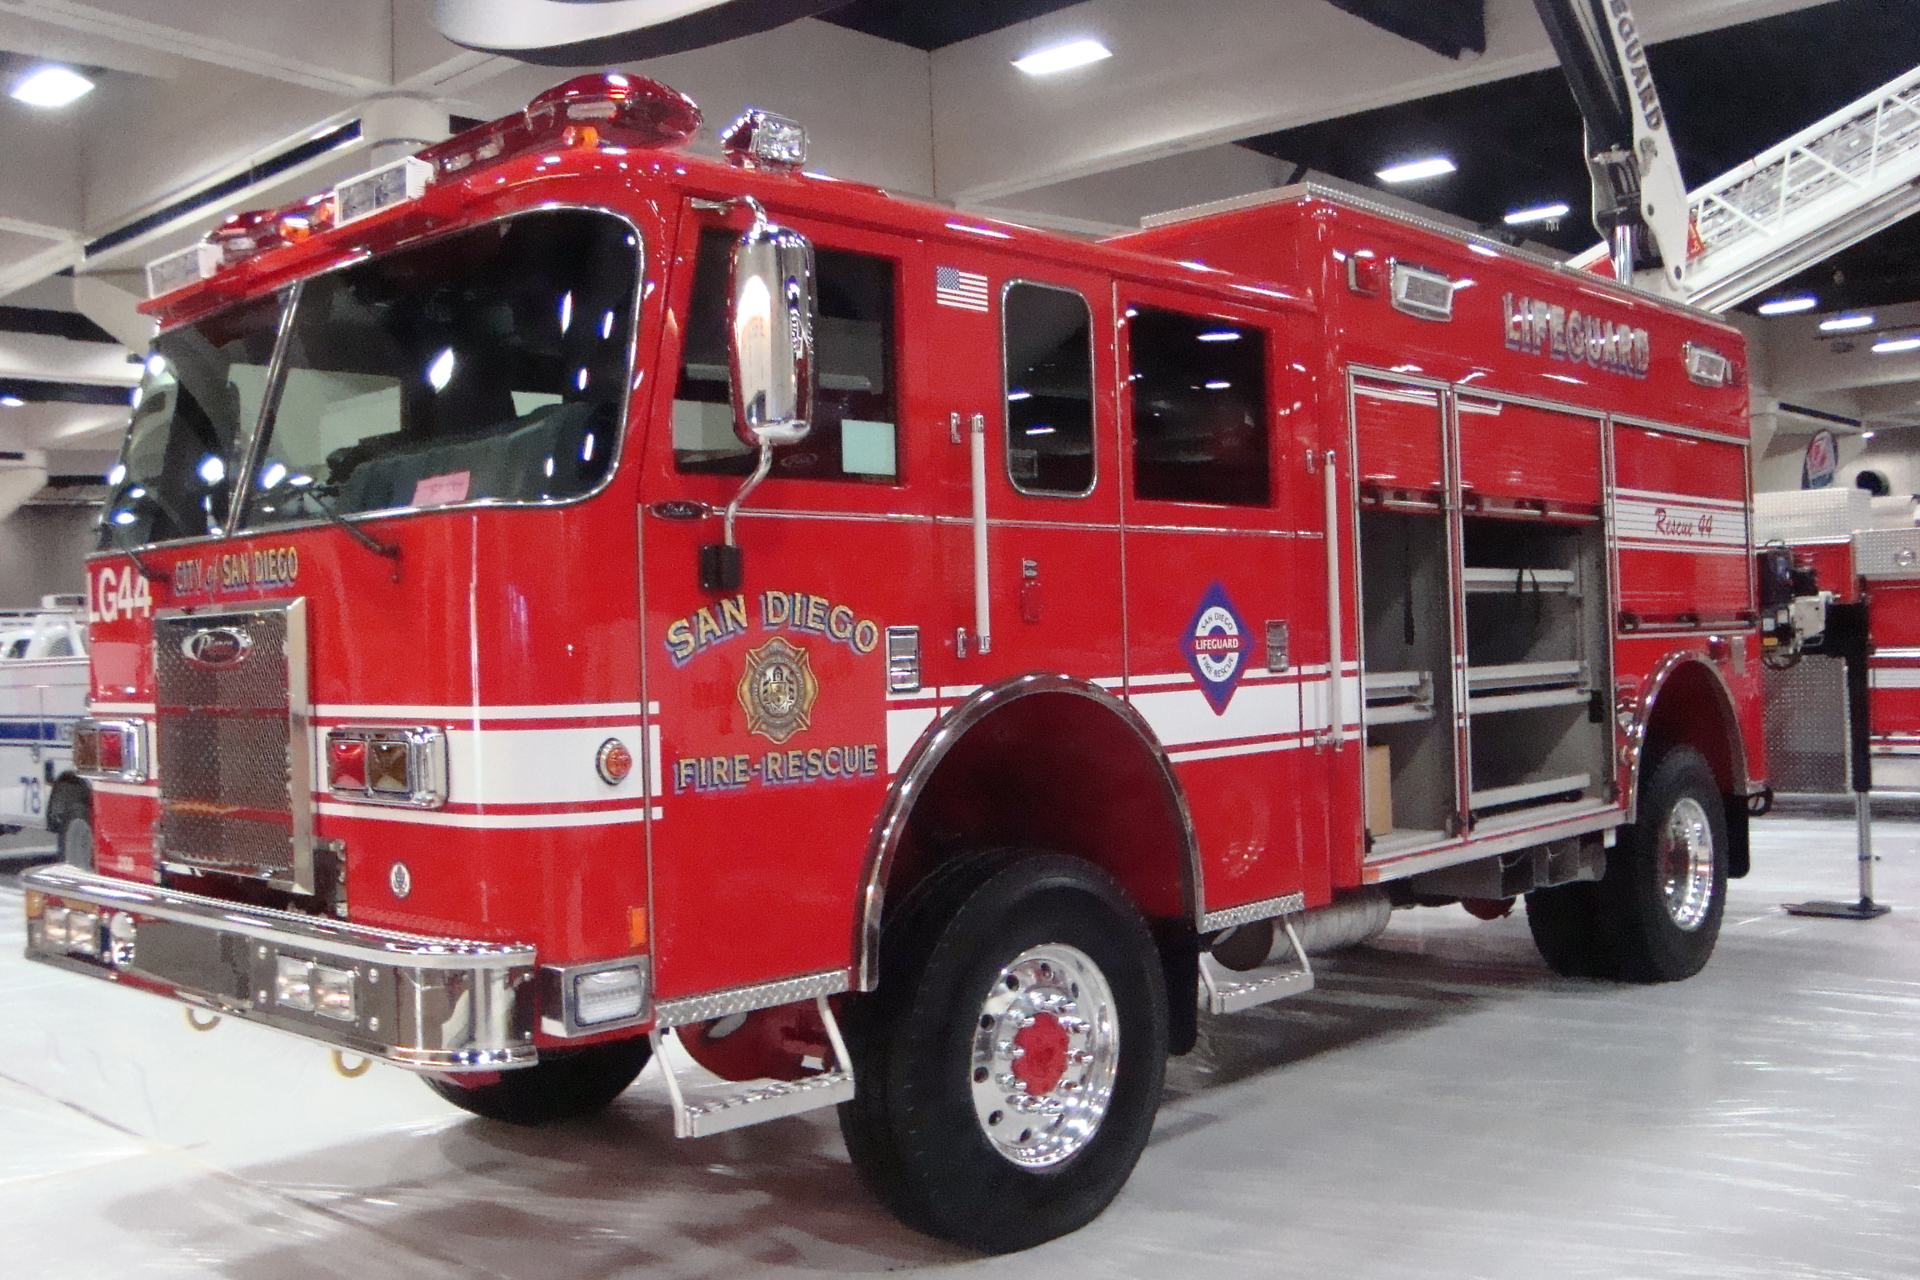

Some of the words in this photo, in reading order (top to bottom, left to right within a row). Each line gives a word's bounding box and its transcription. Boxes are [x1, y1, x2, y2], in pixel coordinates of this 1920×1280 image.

[1502, 291, 1650, 379] LIFEGUARD
[1654, 507, 1693, 537] Rescue
[1698, 514, 1713, 538] 44
[88, 566, 152, 623] LG44
[175, 559, 203, 596] CITY
[222, 554, 250, 592] SAN
[253, 546, 299, 590] DIEGO
[665, 594, 748, 668] SAN
[759, 590, 879, 655] DIEGO
[1195, 638, 1239, 650] LIFEGUARD
[1202, 615, 1213, 630] SAN
[1214, 613, 1233, 630] DIEGO
[1202, 656, 1213, 674] FIRE
[1213, 659, 1234, 677] RESCUE
[675, 744, 879, 794] FIRE-RESCUE
